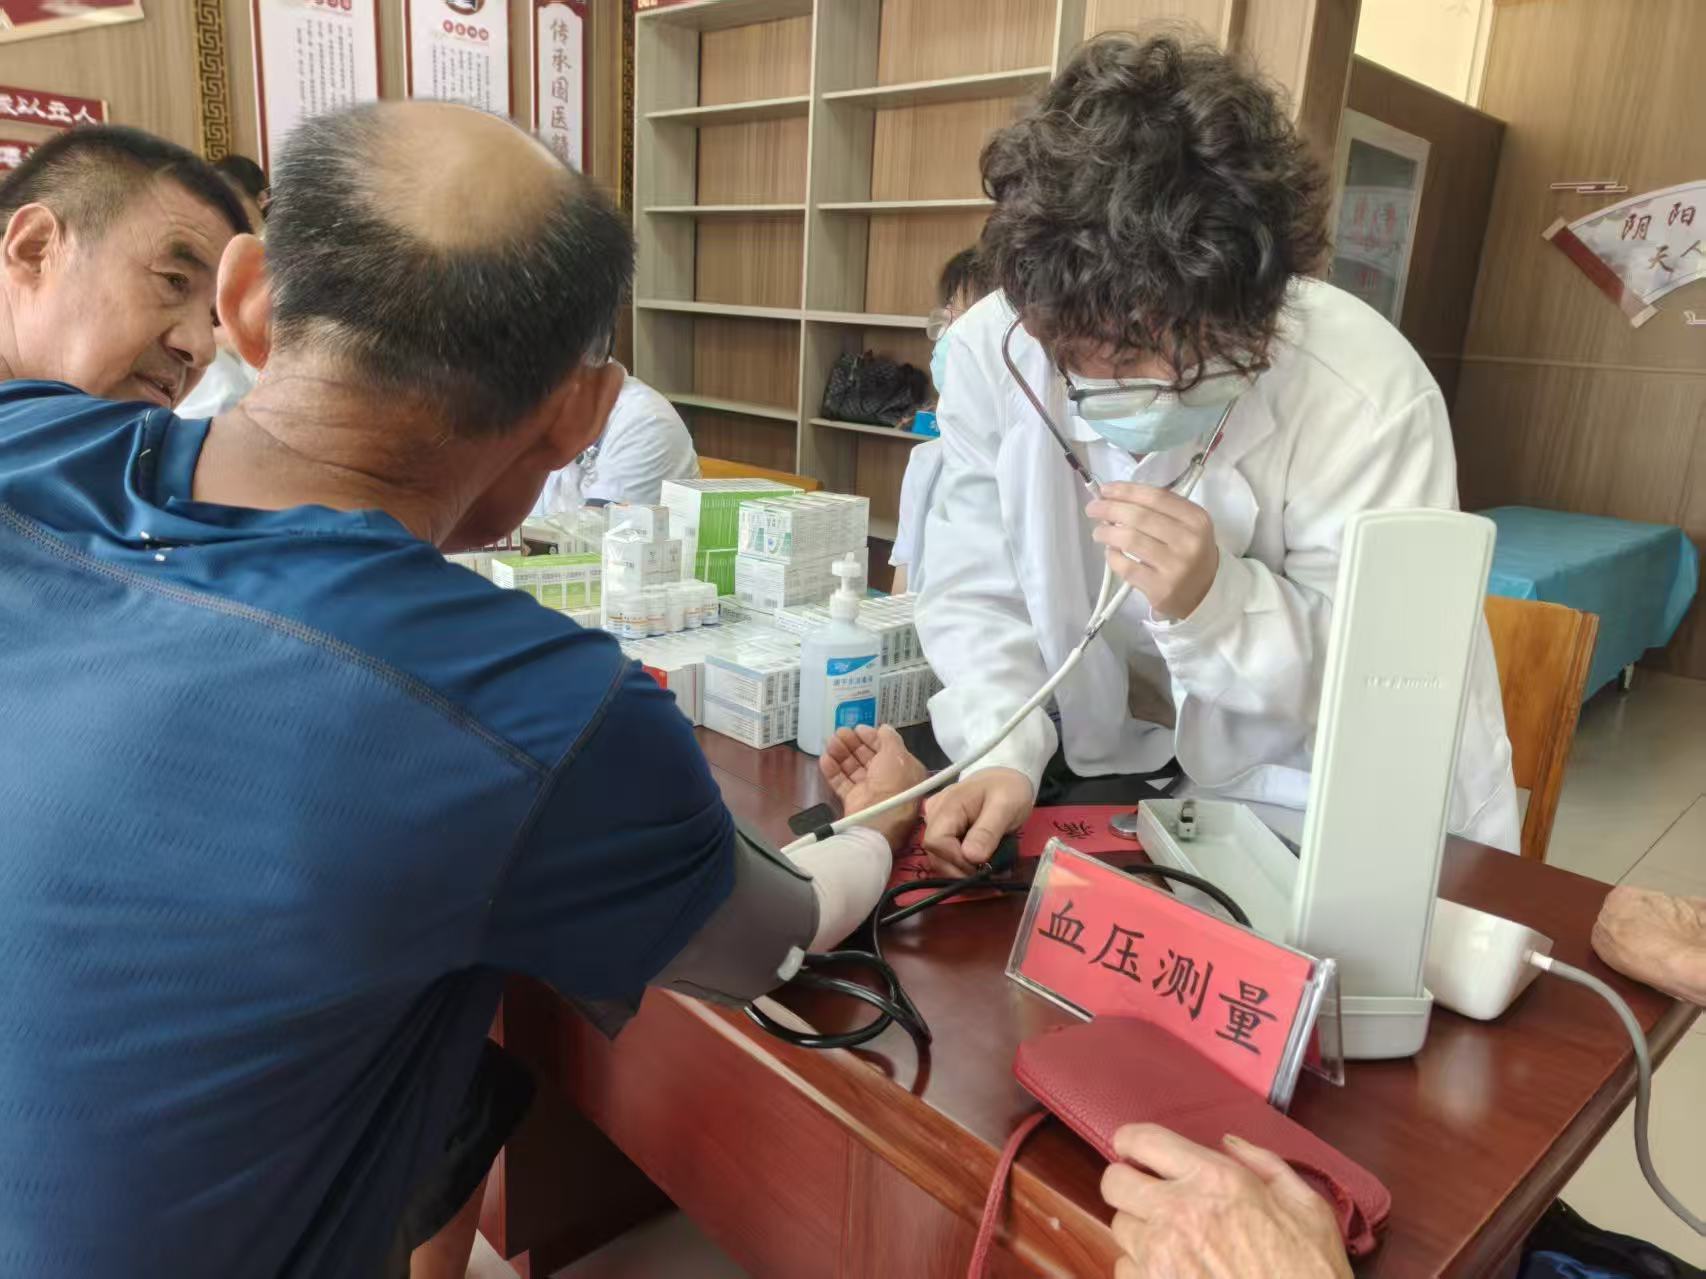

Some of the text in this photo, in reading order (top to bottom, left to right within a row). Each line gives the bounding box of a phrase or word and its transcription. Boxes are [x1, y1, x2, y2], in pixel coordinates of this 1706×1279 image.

[1621, 202, 1696, 240] 阴阳
[1037, 899, 1278, 1056] 血压测量
